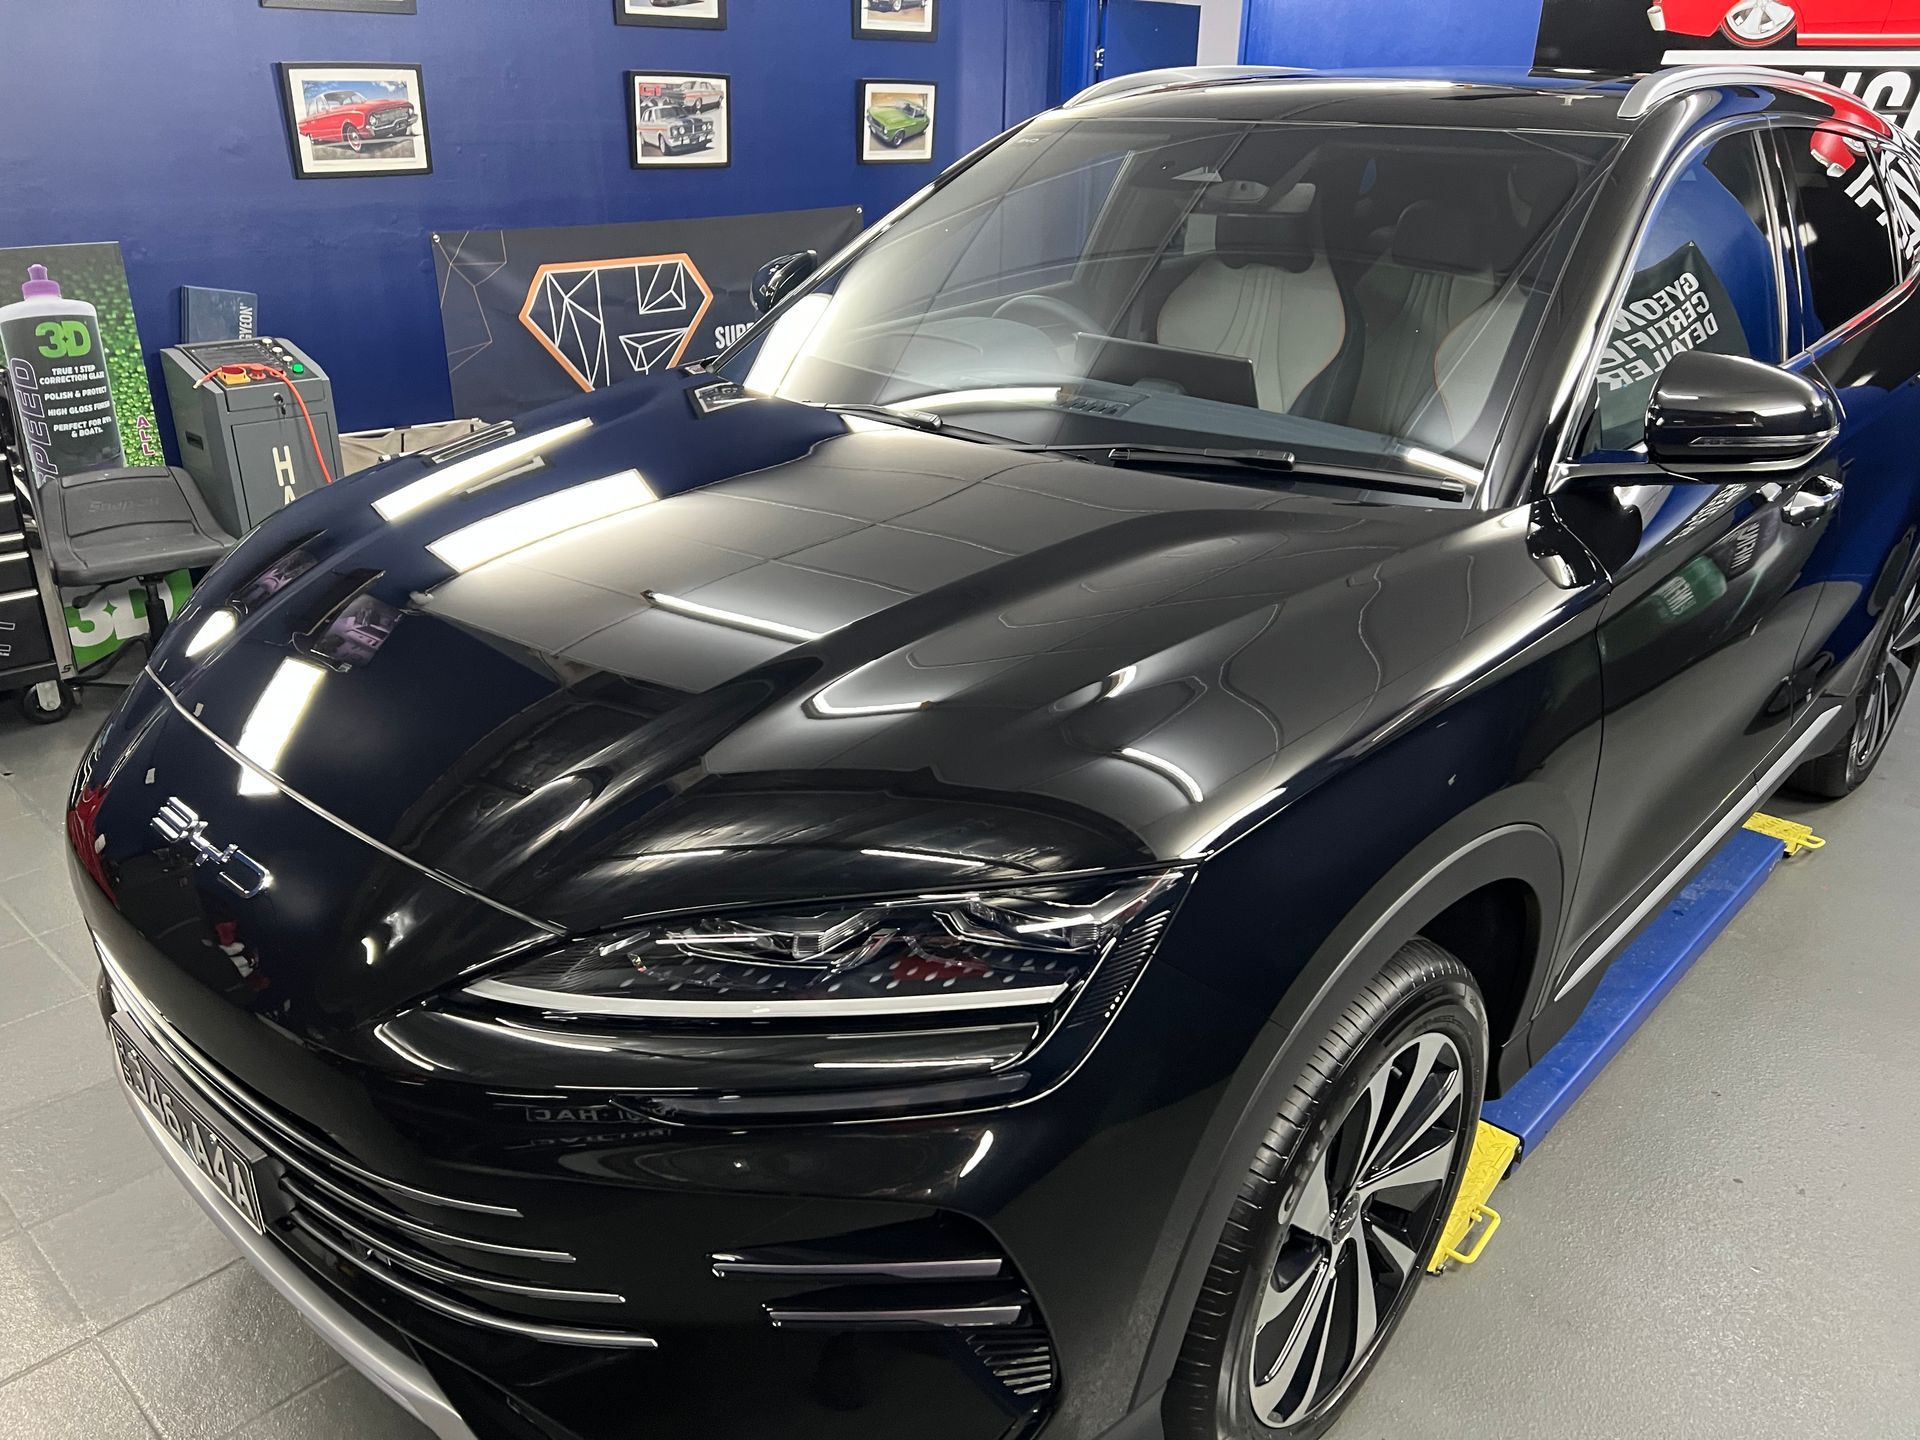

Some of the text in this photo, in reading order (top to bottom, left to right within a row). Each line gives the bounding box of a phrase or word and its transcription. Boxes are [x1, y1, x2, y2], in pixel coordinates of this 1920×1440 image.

[239, 304, 253, 340] GYEON
[35, 321, 91, 358] 3D
[51, 364, 96, 376] TRUE 1 STEP
[39, 373, 88, 385] CORRECTION
[44, 386, 107, 401] POLISH & PROTECT
[47, 407, 68, 417] HIGH
[69, 404, 93, 414] GLOSS
[53, 421, 87, 432] PERFECT
[88, 419, 102, 428] FOR
[137, 414, 155, 456] ALL
